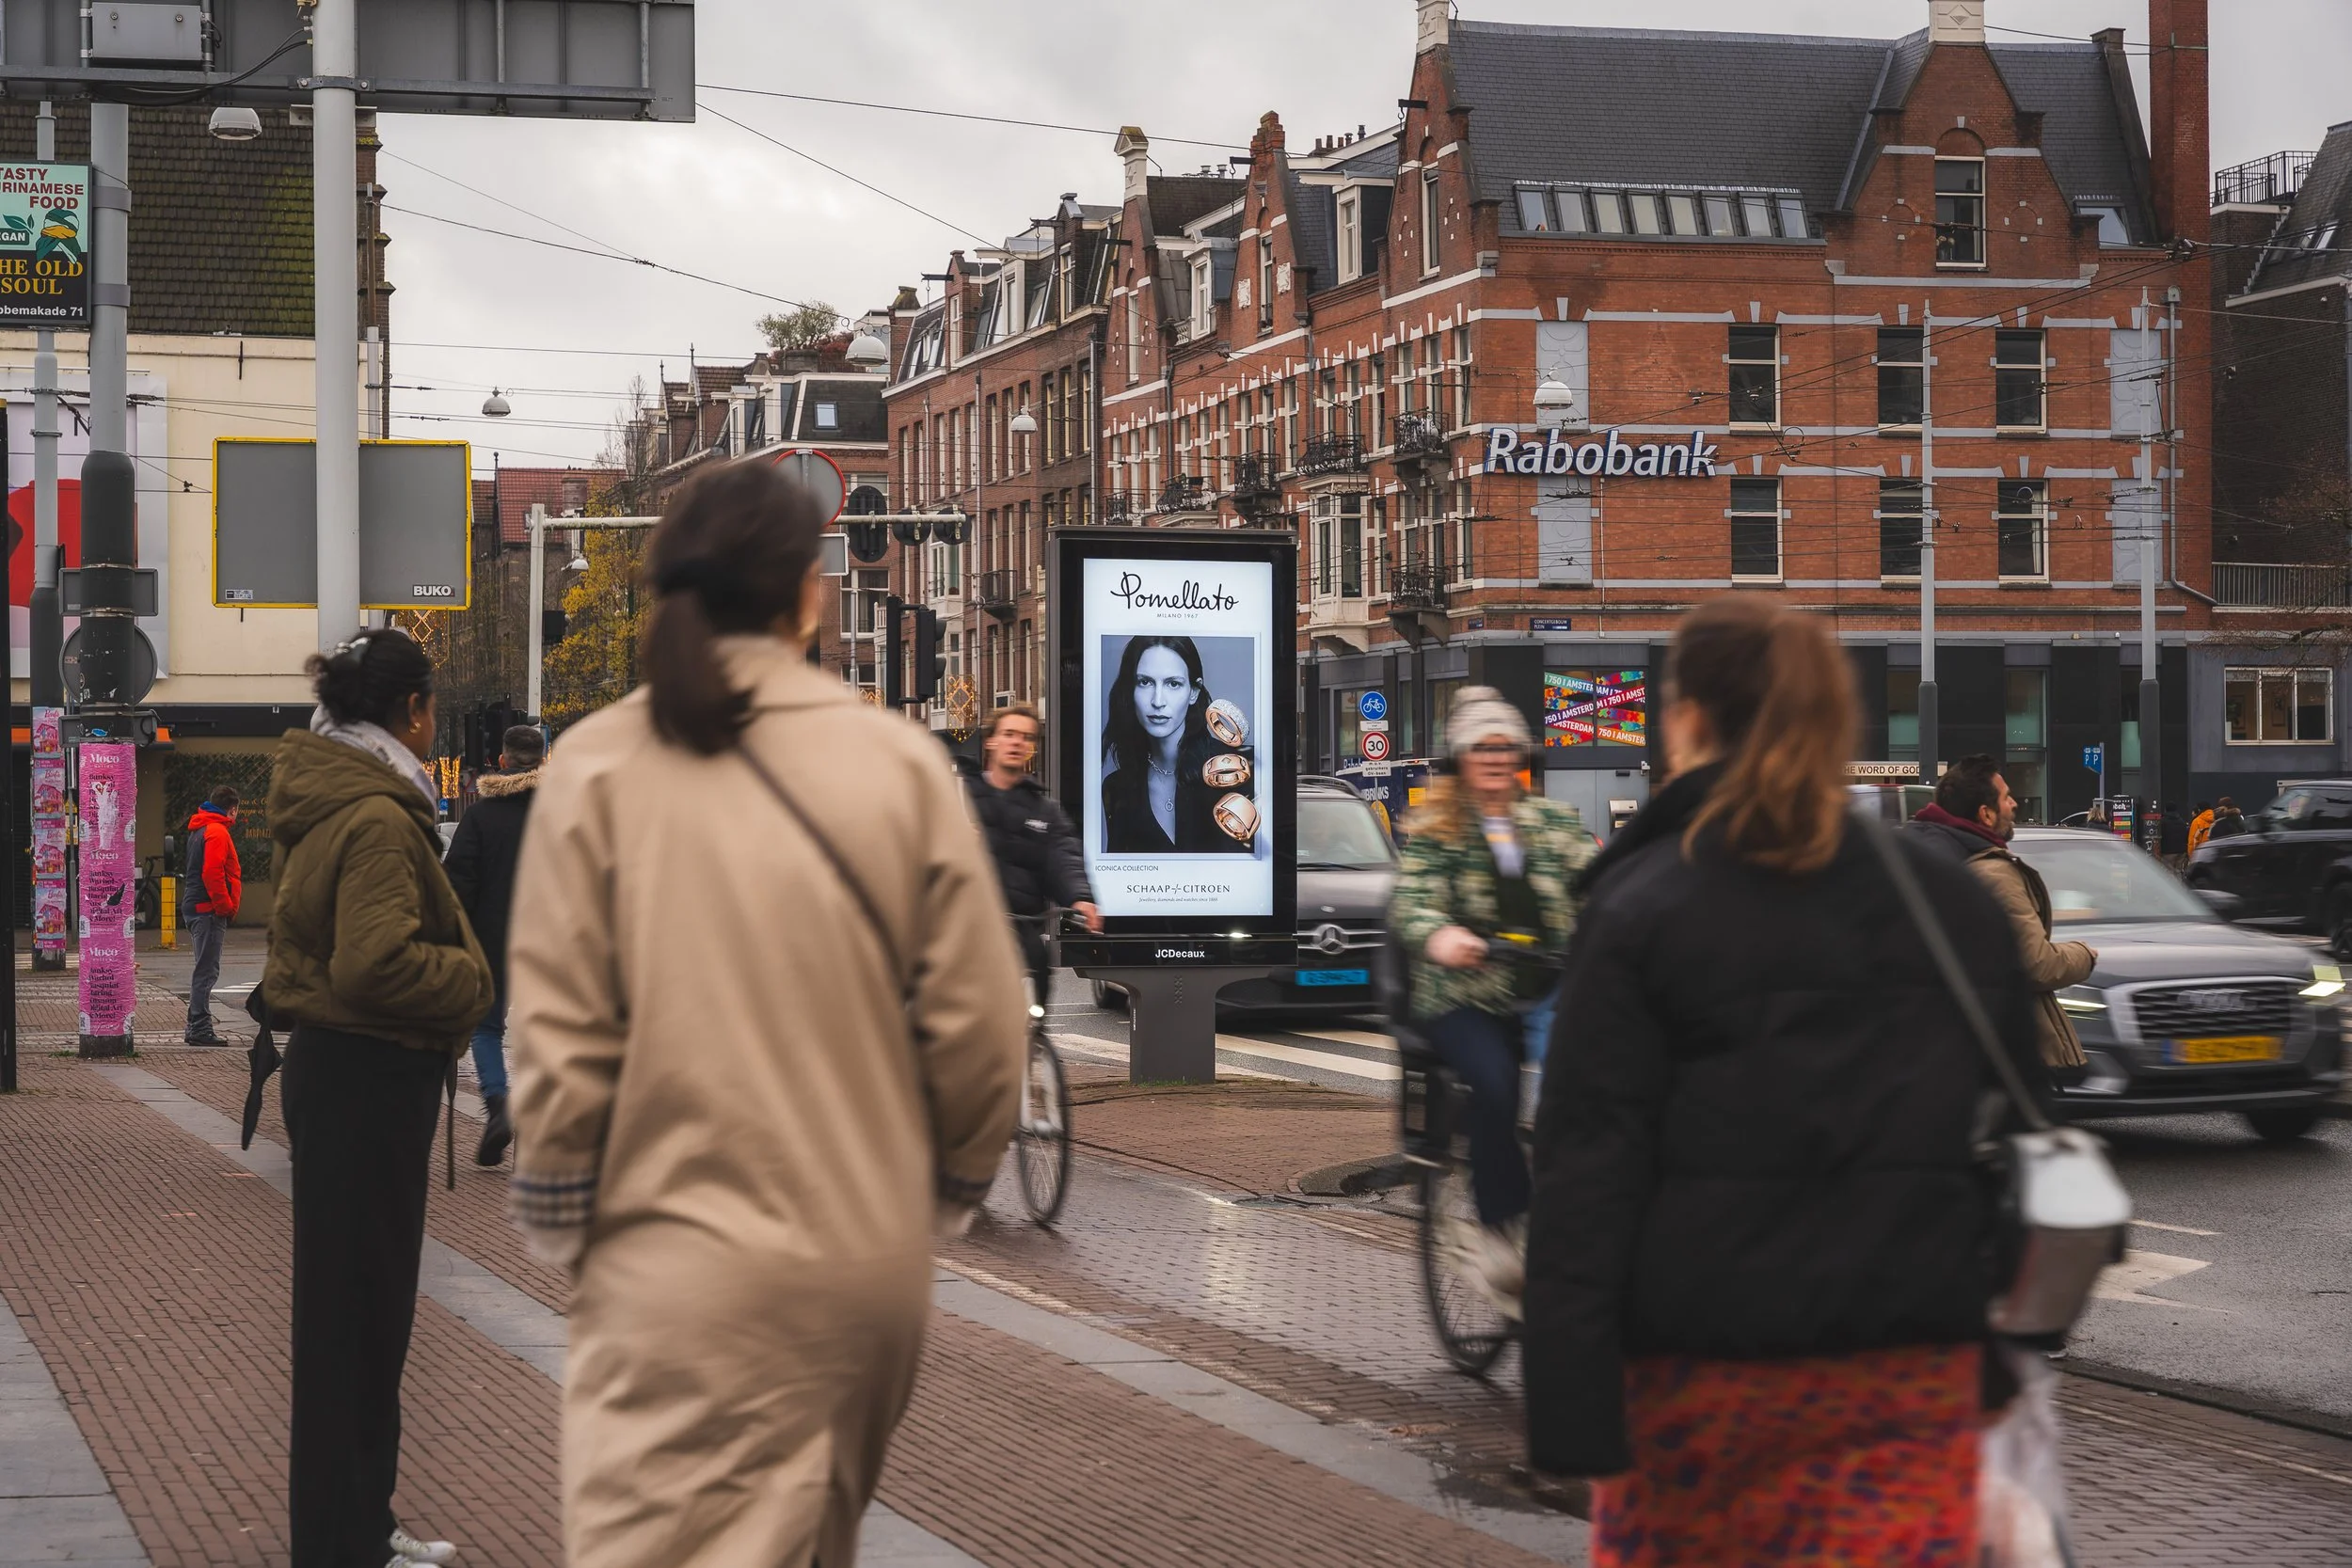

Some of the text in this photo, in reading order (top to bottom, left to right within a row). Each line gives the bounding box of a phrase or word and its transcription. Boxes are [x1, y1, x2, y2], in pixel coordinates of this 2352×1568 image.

[0, 182, 84, 196] RINAMESE
[29, 196, 79, 210] FOOD
[0, 231, 25, 242] GAN
[35, 260, 84, 277] OLD
[1, 277, 63, 294] SOUL
[70, 307, 84, 317] 71
[1486, 427, 1718, 476] Rabobank
[413, 585, 452, 596] BUKO
[1110, 571, 1239, 610] Pomellato
[1549, 675, 1562, 686] 750
[1608, 694, 1621, 705] 750
[1626, 687, 1645, 701] AMST
[1545, 715, 1557, 724] 750
[1598, 728, 1612, 738] 750
[1368, 740, 1384, 752] 30
[89, 753, 119, 764] Moco
[2085, 754, 2099, 765] P P
[1857, 766, 1885, 774] WORD
[1887, 766, 1900, 774] OF
[1126, 884, 1231, 894] SCHAAP CITROEN
[1155, 949, 1205, 958] JCDecaux
